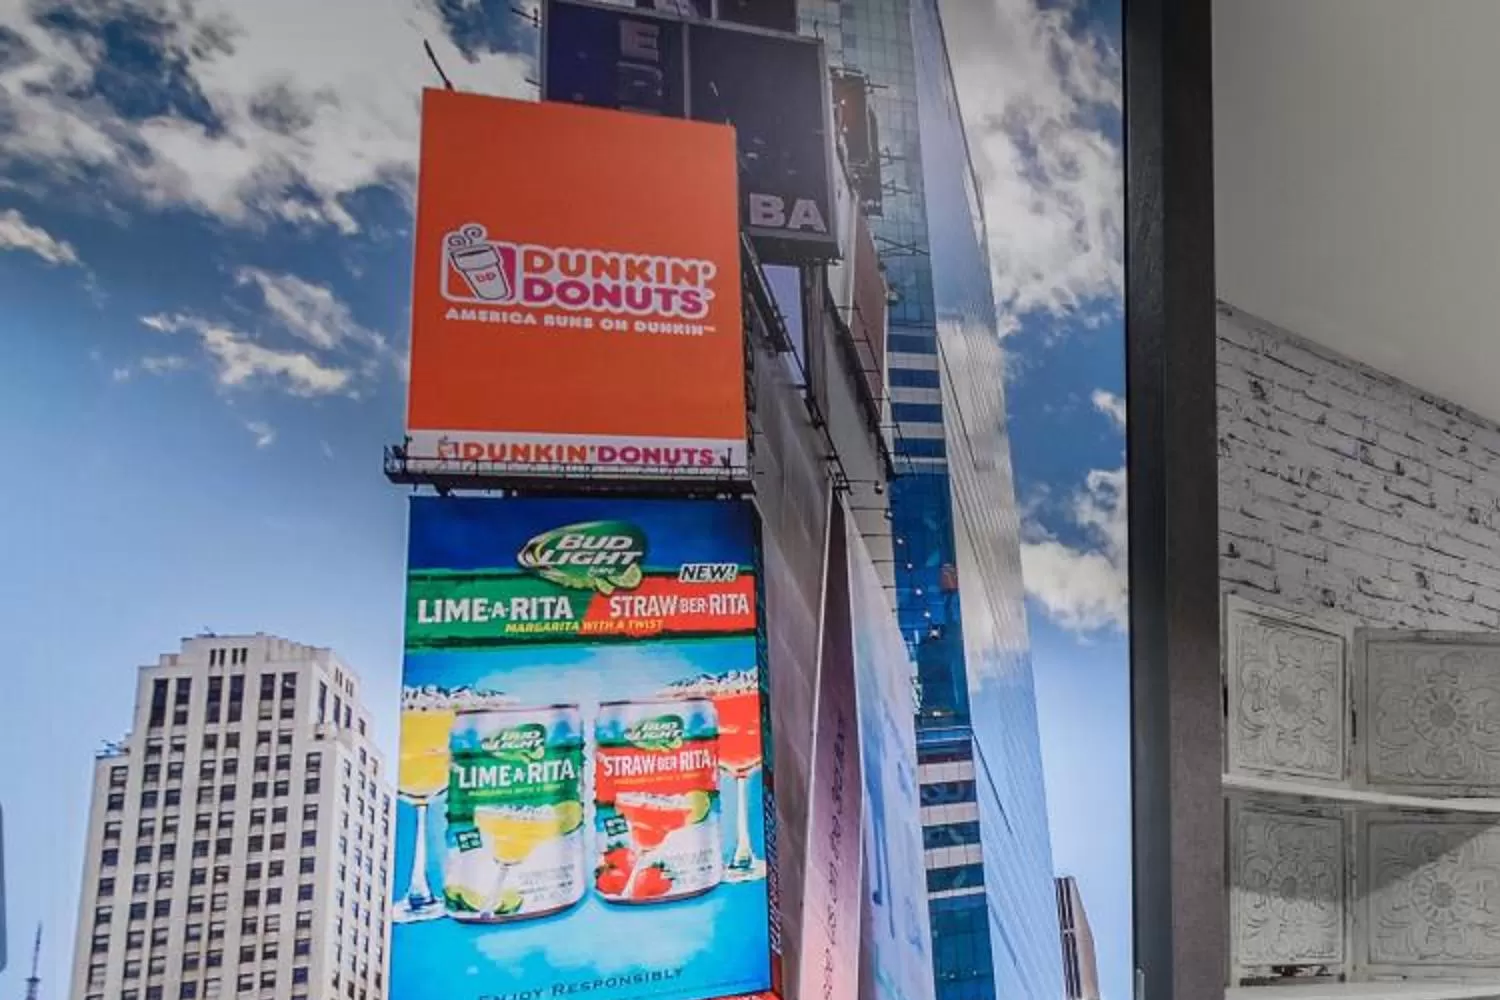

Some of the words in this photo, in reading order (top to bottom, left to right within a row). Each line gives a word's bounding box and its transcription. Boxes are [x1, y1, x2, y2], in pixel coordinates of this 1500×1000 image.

[522, 277, 705, 315] DONUTS
[446, 307, 537, 326] AMERICA
[544, 313, 593, 329] RUNS
[600, 317, 629, 332] ON
[596, 445, 714, 466] DONUTS
[555, 533, 633, 550] BUD
[538, 550, 643, 566] LIGHT
[681, 564, 737, 582] NEW!
[505, 621, 580, 633] MARGARITA
